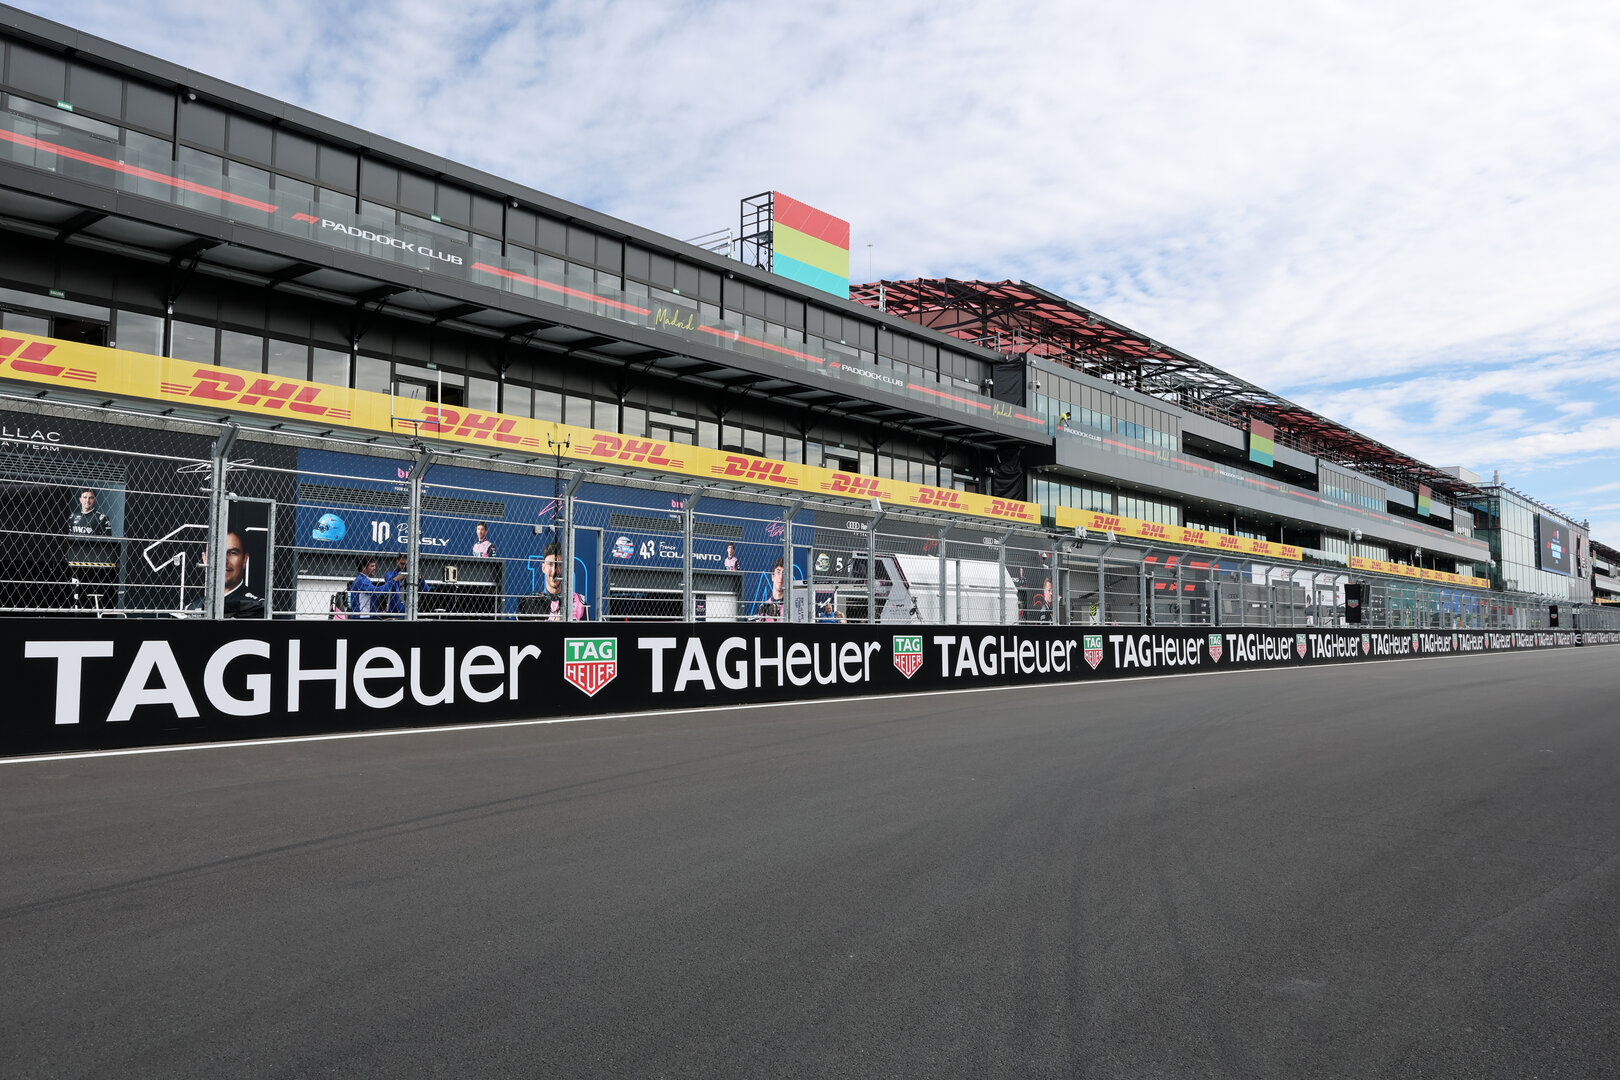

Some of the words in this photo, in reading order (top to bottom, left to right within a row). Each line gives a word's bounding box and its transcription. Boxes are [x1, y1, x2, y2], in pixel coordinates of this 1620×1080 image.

[321, 218, 416, 253] PADDOCK
[417, 246, 463, 266] CLUB
[655, 307, 695, 331] Madrid
[841, 364, 882, 381] PADDOCK
[882, 376, 904, 387] CLUB
[190, 369, 329, 416] DHL
[418, 407, 522, 445] DHL
[590, 434, 671, 466] DHL
[723, 455, 788, 484] DHL
[831, 473, 883, 497] DHL
[918, 487, 962, 509] DHL
[991, 500, 1028, 519] DHL
[371, 520, 390, 545] 10
[1094, 515, 1121, 532] DHL
[1141, 523, 1166, 538] DHL
[397, 535, 450, 547] GSLY
[639, 539, 655, 560] 43
[569, 641, 613, 660] TAG
[895, 638, 920, 652] TAG
[1085, 637, 1101, 648] TAG
[895, 654, 922, 675] HEUER
[567, 663, 614, 692] HEUER
